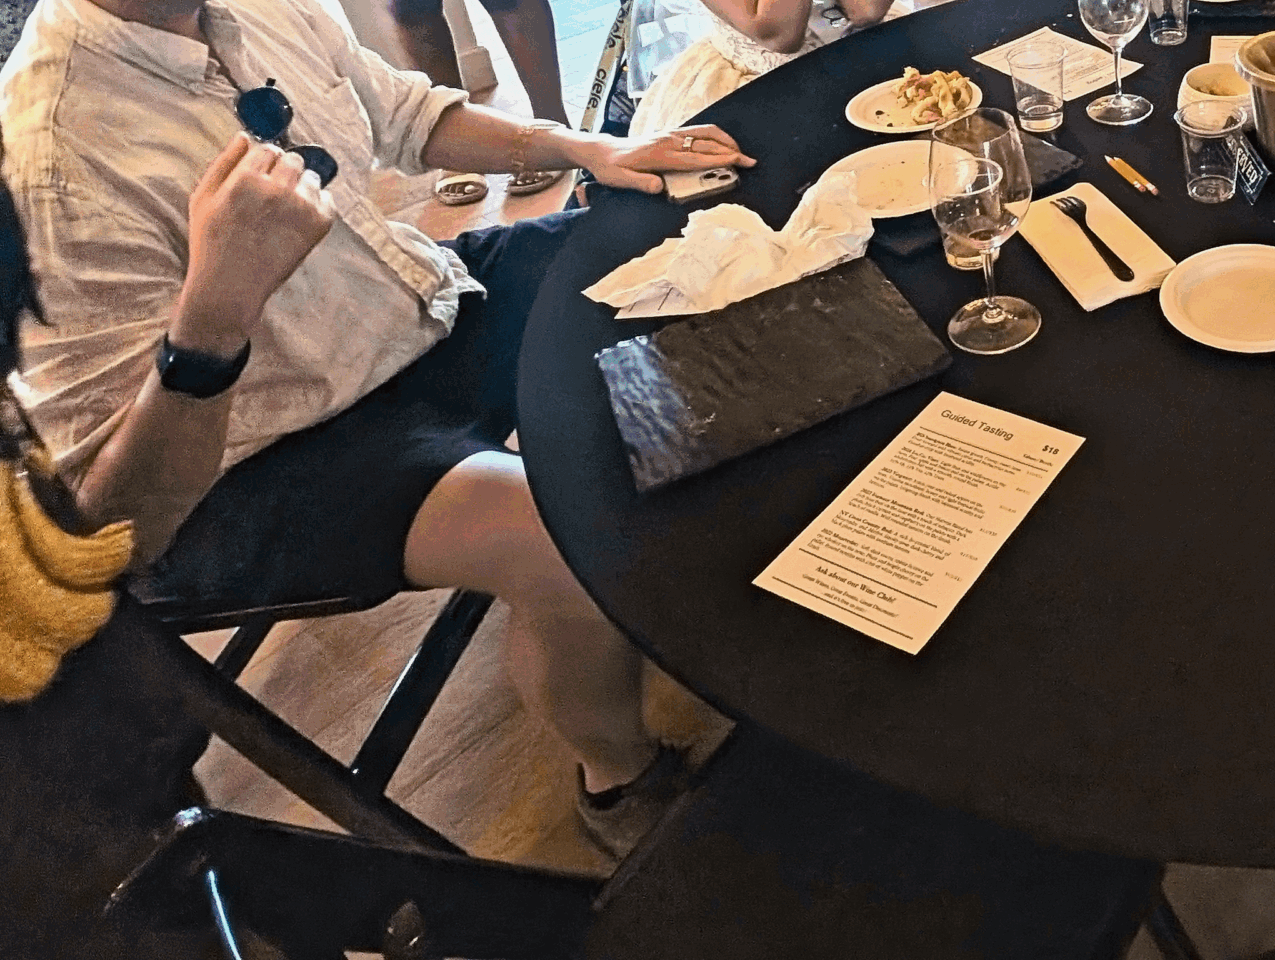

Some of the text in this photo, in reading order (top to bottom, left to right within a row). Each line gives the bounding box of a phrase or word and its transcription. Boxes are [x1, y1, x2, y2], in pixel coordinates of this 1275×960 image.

[586, 68, 607, 111] ciele.
[940, 409, 1014, 441] Guided Tasting
[1041, 444, 1059, 454] $18
[815, 565, 896, 603] Ask about our Wine Club!
